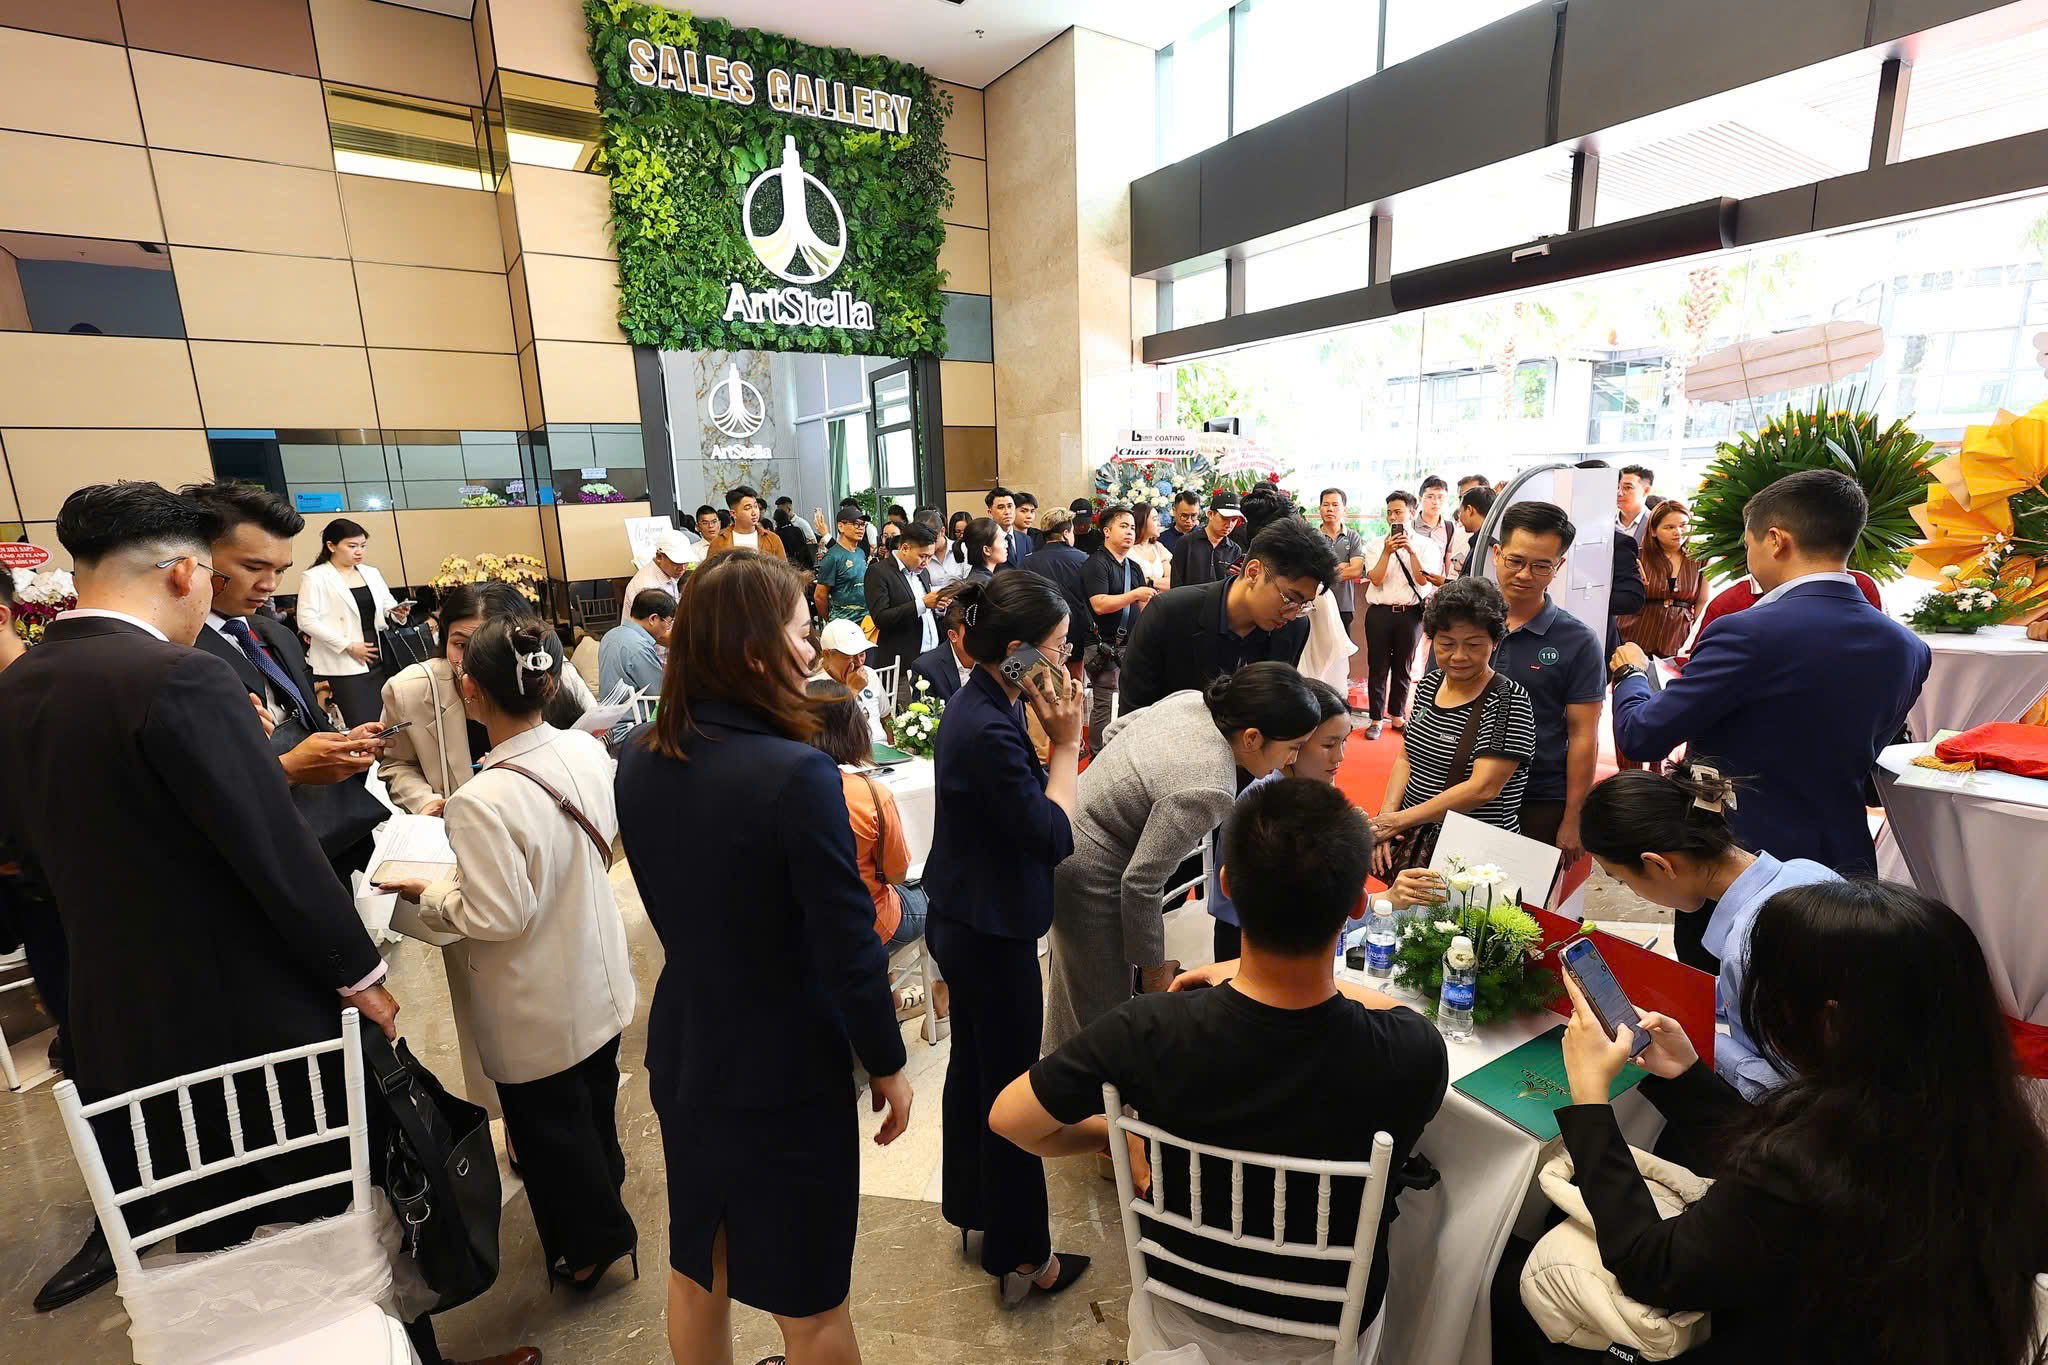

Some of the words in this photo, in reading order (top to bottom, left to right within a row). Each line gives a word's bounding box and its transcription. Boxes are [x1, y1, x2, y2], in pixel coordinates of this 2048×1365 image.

[629, 39, 755, 105] SALES
[767, 69, 911, 133] GALLERY
[722, 282, 874, 330] ArtStella
[711, 444, 772, 459] ArtStella
[1119, 447, 1151, 455] Chúc
